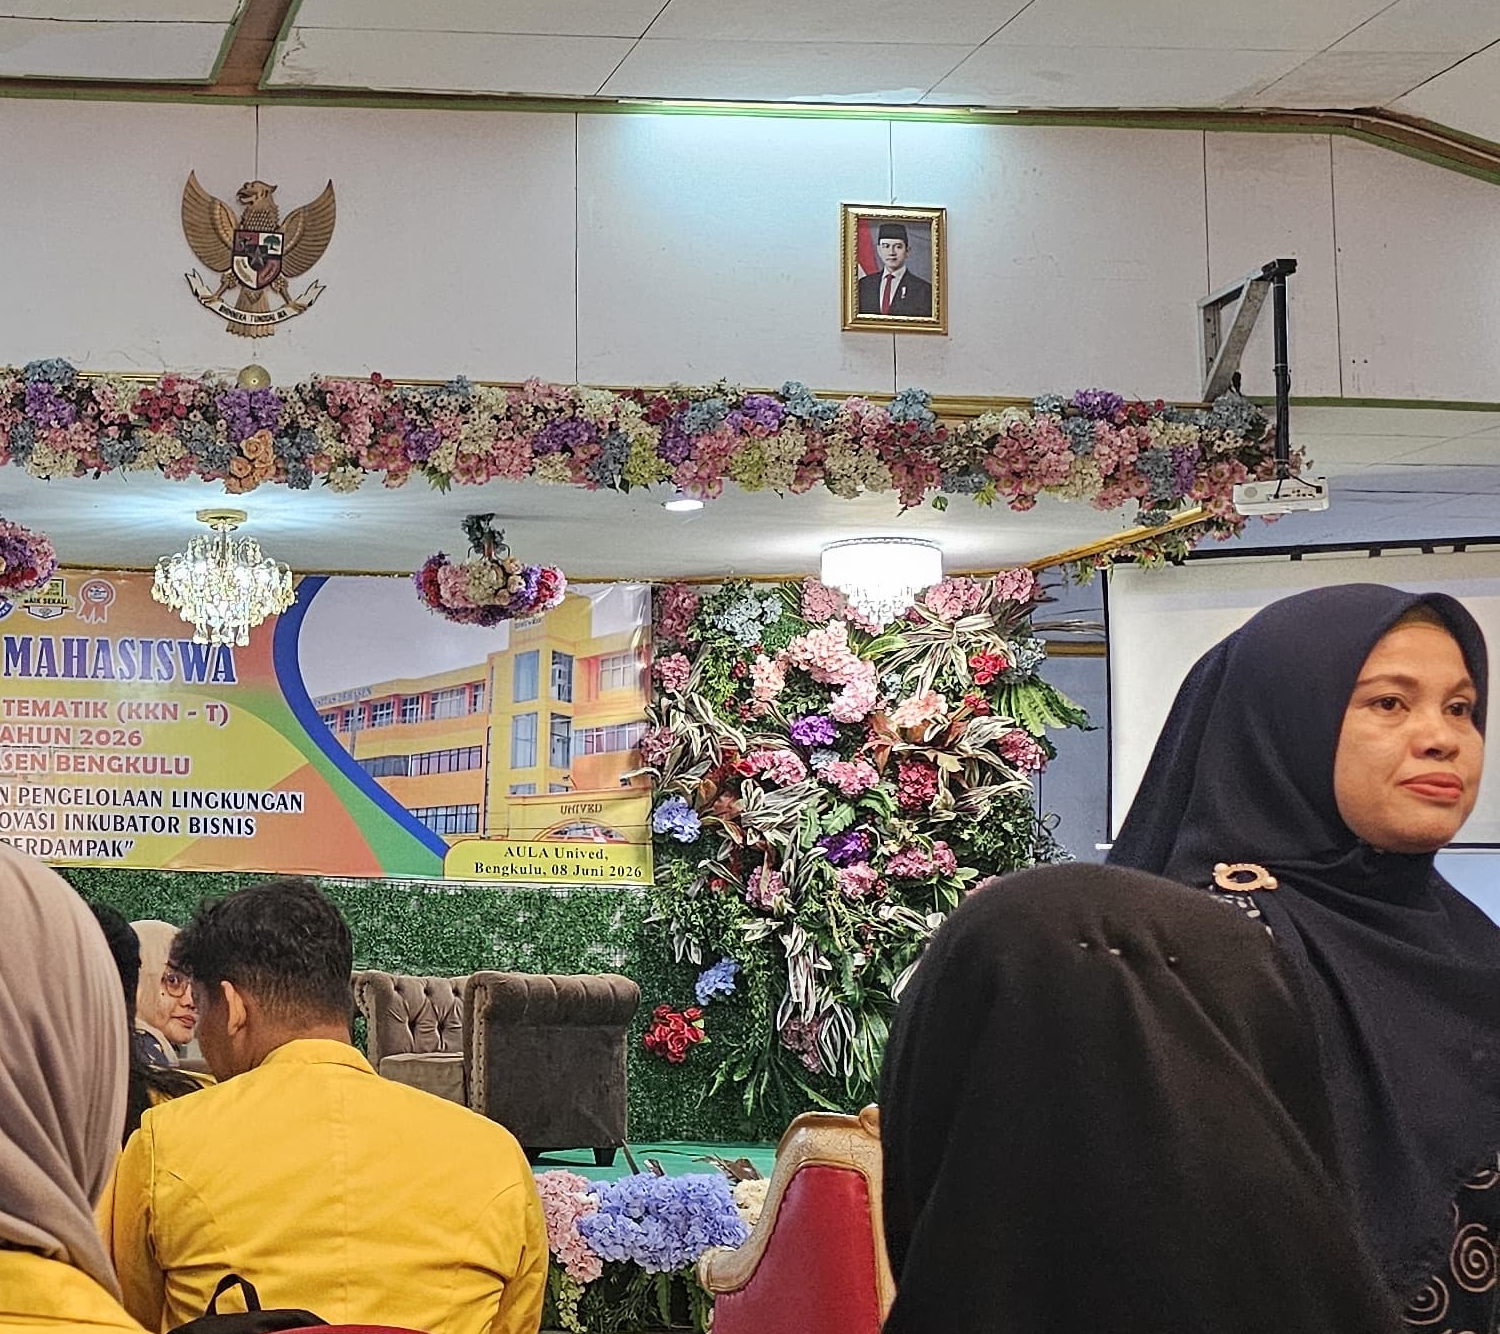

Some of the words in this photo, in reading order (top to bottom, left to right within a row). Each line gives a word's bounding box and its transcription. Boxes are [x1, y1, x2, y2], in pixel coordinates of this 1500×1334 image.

[3, 636, 236, 683] MAHASISWA
[3, 699, 108, 718] TEMATIK
[117, 702, 179, 724] (KKN
[206, 704, 229, 726] T)
[79, 729, 142, 747] 2026
[57, 755, 190, 775] BENGKULU
[18, 787, 163, 808] PENGELOLAAN
[172, 791, 303, 812] LINGKUNGAN
[65, 814, 180, 834] INKUBATOR
[189, 817, 255, 836] BISNIS
[504, 846, 548, 858] AULA
[554, 847, 608, 861] Unived,
[474, 862, 546, 876] Bengkulu,
[552, 865, 568, 875] 08
[572, 864, 603, 876] Juni
[609, 866, 642, 877] 2026
